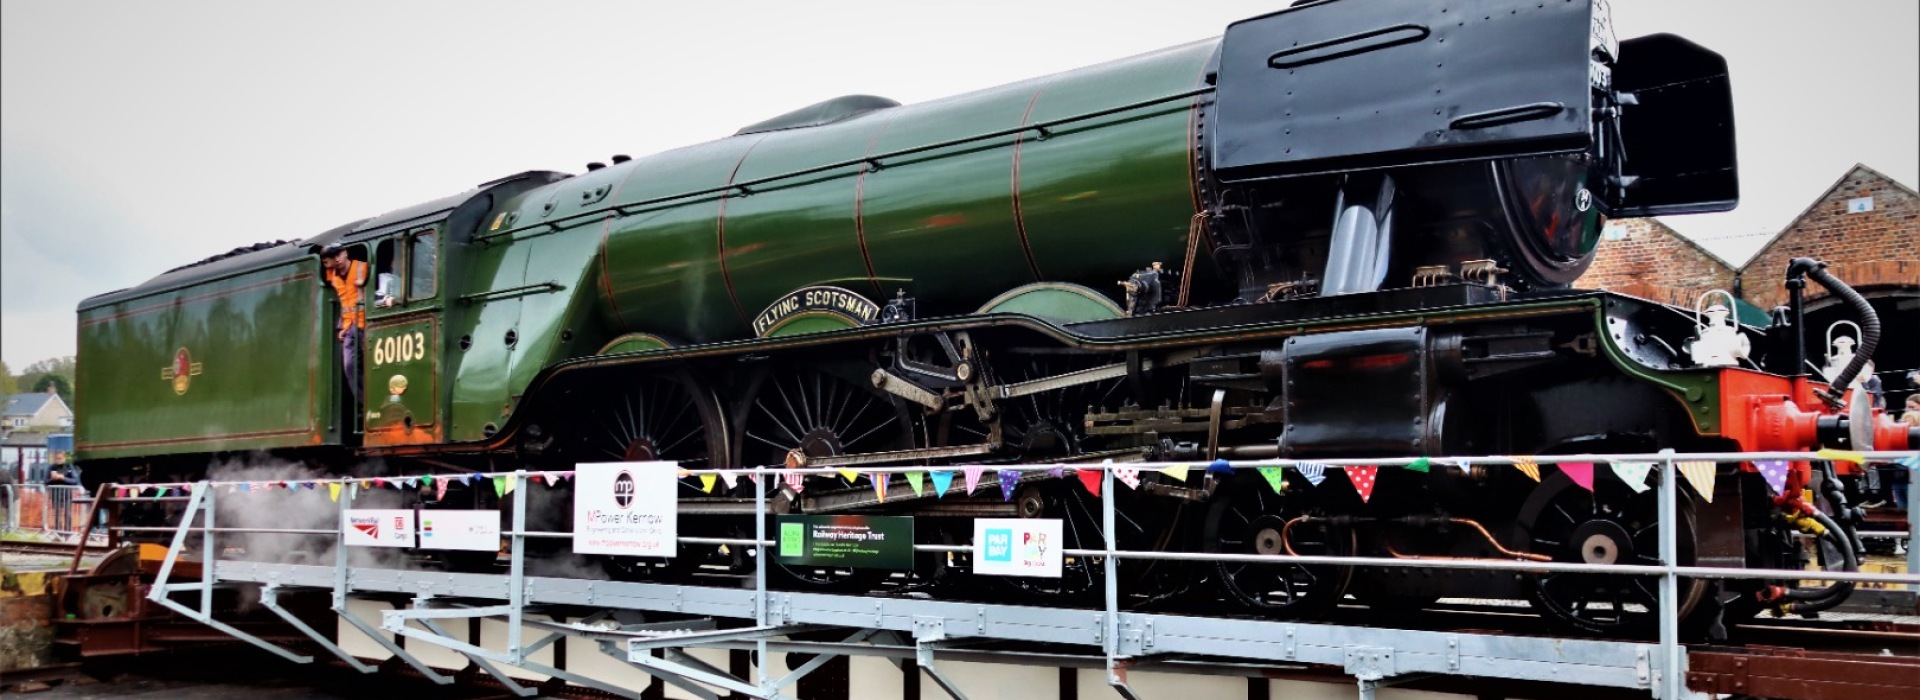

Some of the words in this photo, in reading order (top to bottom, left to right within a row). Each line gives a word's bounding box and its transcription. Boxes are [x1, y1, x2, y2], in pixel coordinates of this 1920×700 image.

[759, 296, 799, 333] FLYING
[805, 290, 873, 321] SCOTSMAN
[374, 332, 425, 366] 60103
[812, 530, 838, 541] Railway
[838, 531, 866, 542] Heritage
[867, 531, 885, 541] Trust
